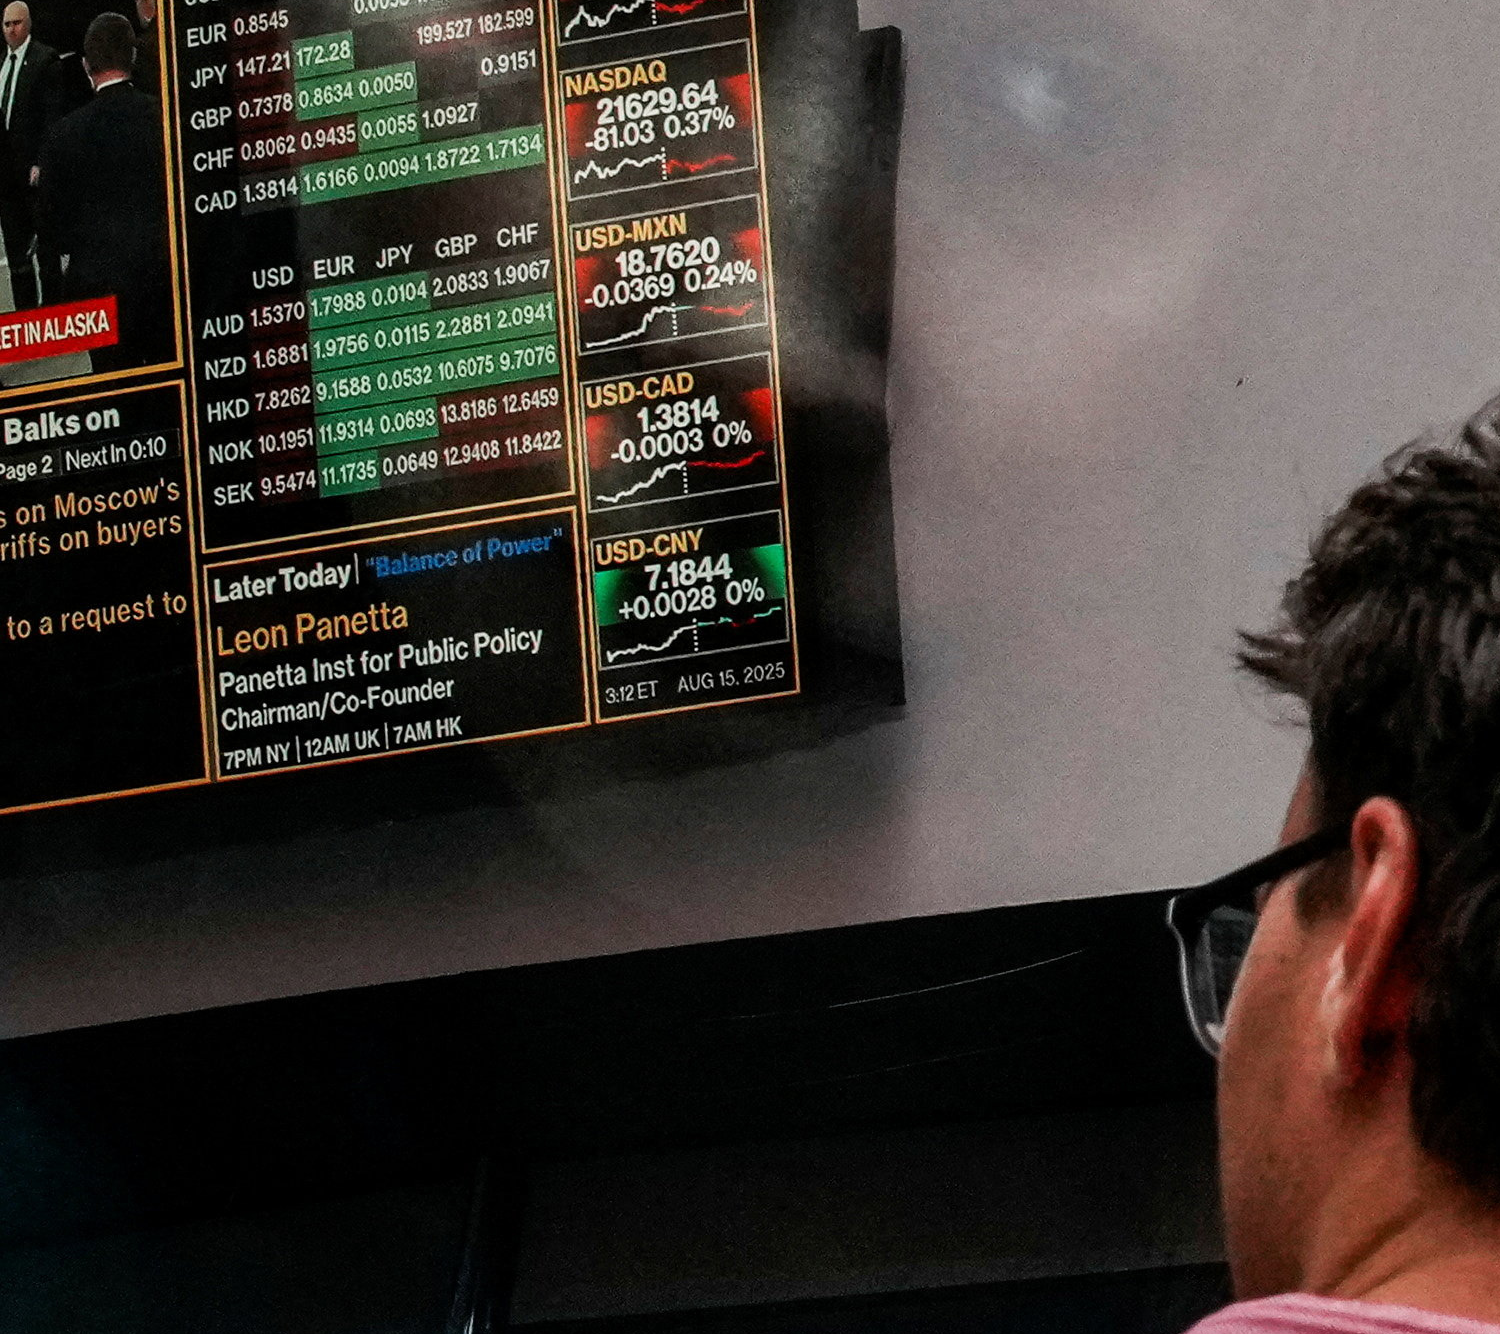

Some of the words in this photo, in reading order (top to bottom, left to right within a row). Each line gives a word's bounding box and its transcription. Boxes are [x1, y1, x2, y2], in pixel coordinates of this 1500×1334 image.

[186, 22, 226, 47] EUR
[233, 9, 289, 37] 0.8545
[189, 64, 228, 90] JPY
[236, 50, 291, 78] 147.21
[296, 39, 351, 68] 172.28
[417, 18, 473, 46] 199.527
[477, 7, 534, 35] 182.599
[190, 105, 232, 131] GBP
[238, 92, 293, 119] 0.7378
[298, 81, 353, 109] 0.8634
[358, 70, 414, 98] 0.0050
[480, 49, 536, 77] 0.9151
[565, 59, 666, 100] NASDAQ
[596, 78, 718, 125] 21629.64
[193, 146, 234, 173] CHF
[241, 133, 296, 162] 0.8062
[301, 123, 356, 151] 0.9435
[361, 112, 416, 141] 0.0055
[422, 102, 478, 130] 1.0927
[584, 119, 654, 153] -81.03
[663, 105, 735, 140] 0.37%
[575, 213, 687, 252] USD-MXN
[615, 236, 721, 279] 18.7620
[583, 274, 674, 310] -0.0369
[684, 259, 757, 294] 0.24%
[0, 326, 20, 351] ET
[25, 322, 40, 346] IN
[45, 310, 110, 341] ALASKA
[585, 371, 694, 409] USD-CAD
[4, 412, 80, 445] Balks
[86, 407, 120, 433] on
[637, 396, 720, 435] 1.3814
[41, 455, 53, 475] 2
[65, 444, 107, 472] Next
[111, 442, 127, 465] In
[129, 436, 167, 460] 0:10
[609, 428, 704, 464] -0.0003
[713, 420, 752, 448] 0%
[15, 501, 46, 527] on
[54, 478, 181, 519] Moscow's
[59, 528, 90, 553] on
[98, 514, 182, 547] buyers
[596, 528, 704, 567] USD-CNY
[214, 570, 276, 603] Later
[278, 558, 352, 597] Today
[366, 544, 457, 579] "Balance
[461, 541, 481, 564] of
[486, 528, 562, 560] Power"
[644, 553, 733, 592] 7.1844
[7, 615, 32, 640] to
[38, 615, 53, 636] a
[61, 593, 155, 633] request
[163, 590, 188, 615] to
[618, 584, 716, 622] +0.0028
[724, 577, 765, 606] 0%
[216, 616, 288, 656] Leon
[296, 597, 408, 644] Panetta
[219, 661, 306, 698] Panetta
[313, 653, 354, 682] Inst
[360, 648, 392, 674] for
[398, 635, 468, 669] Public
[473, 623, 543, 662] Policy
[605, 683, 636, 704] 3:12
[637, 679, 659, 699] ET
[678, 672, 714, 693] AUG
[743, 661, 786, 683] 2025
[221, 673, 455, 735] Chairman/Co-Founder
[224, 747, 260, 770] 7PM
[266, 742, 290, 763] NY
[304, 733, 350, 758] 12AM
[355, 728, 380, 750] UK
[392, 720, 432, 744] 7AM
[436, 716, 462, 737] HK
